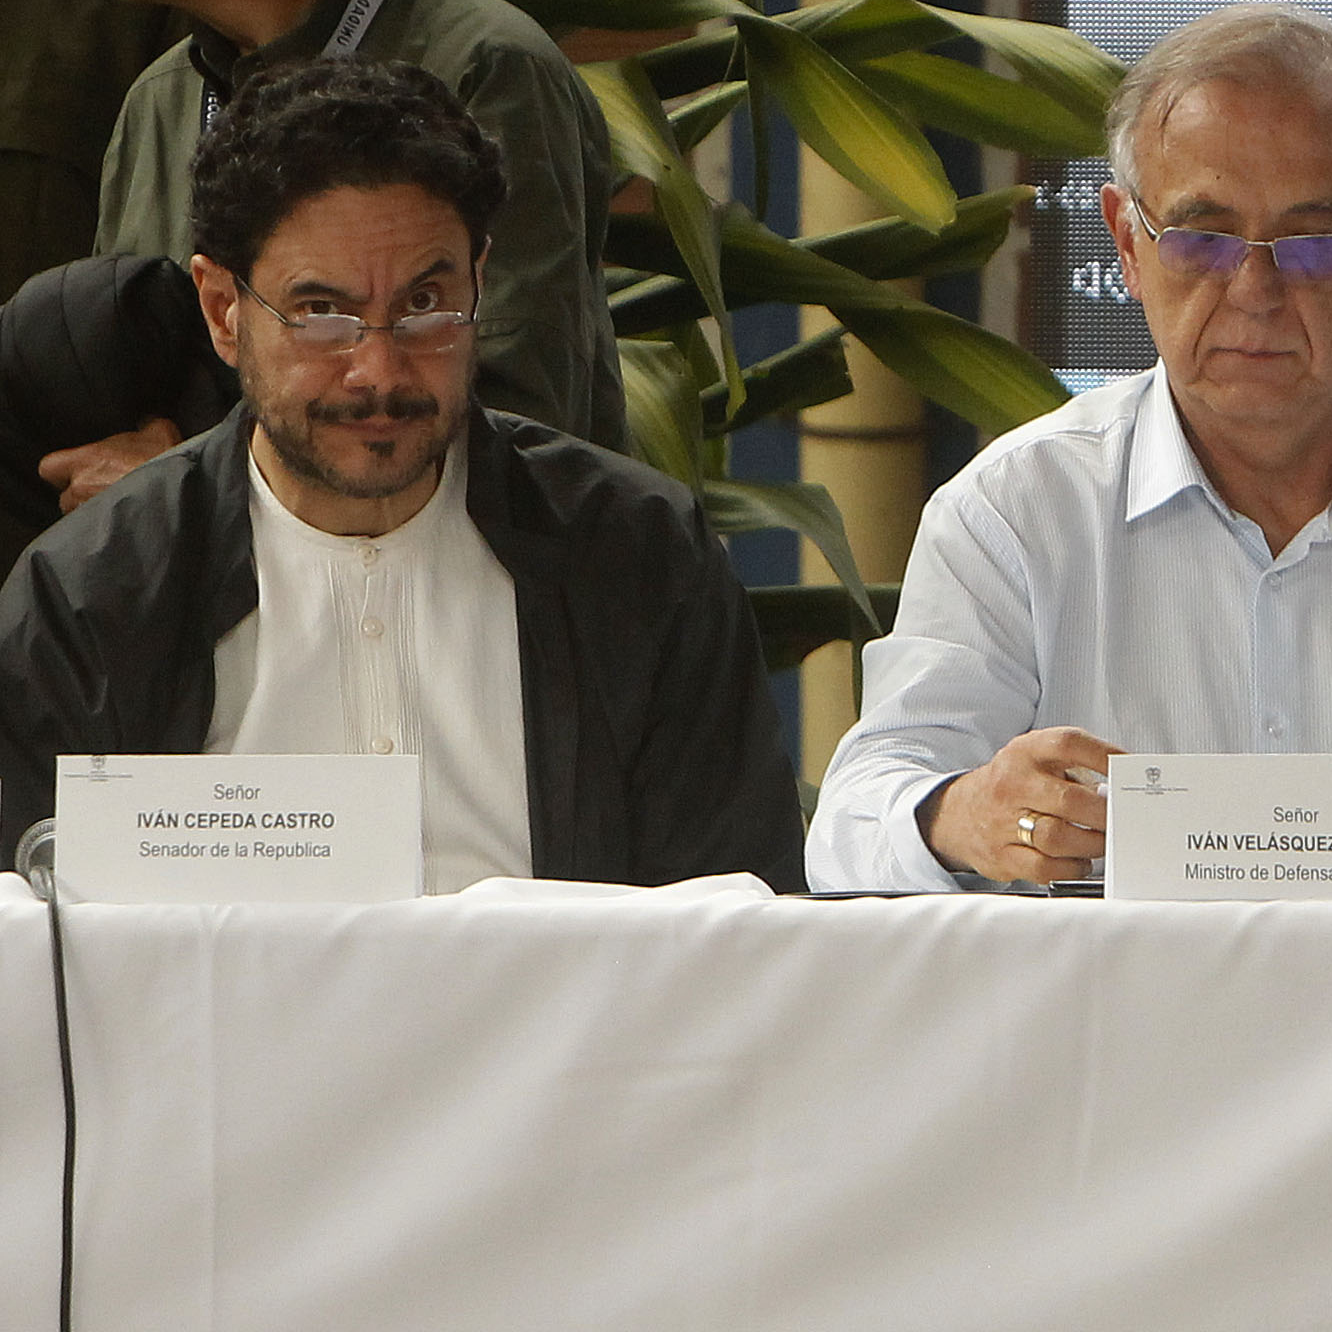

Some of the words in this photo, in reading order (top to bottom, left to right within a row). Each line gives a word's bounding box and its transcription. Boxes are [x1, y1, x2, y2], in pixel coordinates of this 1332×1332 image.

[213, 783, 261, 800] Señor
[137, 809, 179, 829] IVÁN
[184, 812, 257, 829] CEPEDA
[261, 812, 336, 829] CASTRO
[1273, 806, 1319, 823] Señor
[1187, 831, 1228, 850] IVÁN
[139, 841, 206, 858] Senador
[210, 841, 230, 858] de
[235, 841, 248, 858] la
[253, 841, 331, 861] Republica
[1185, 863, 1246, 881] Ministro
[1250, 864, 1269, 881] de
